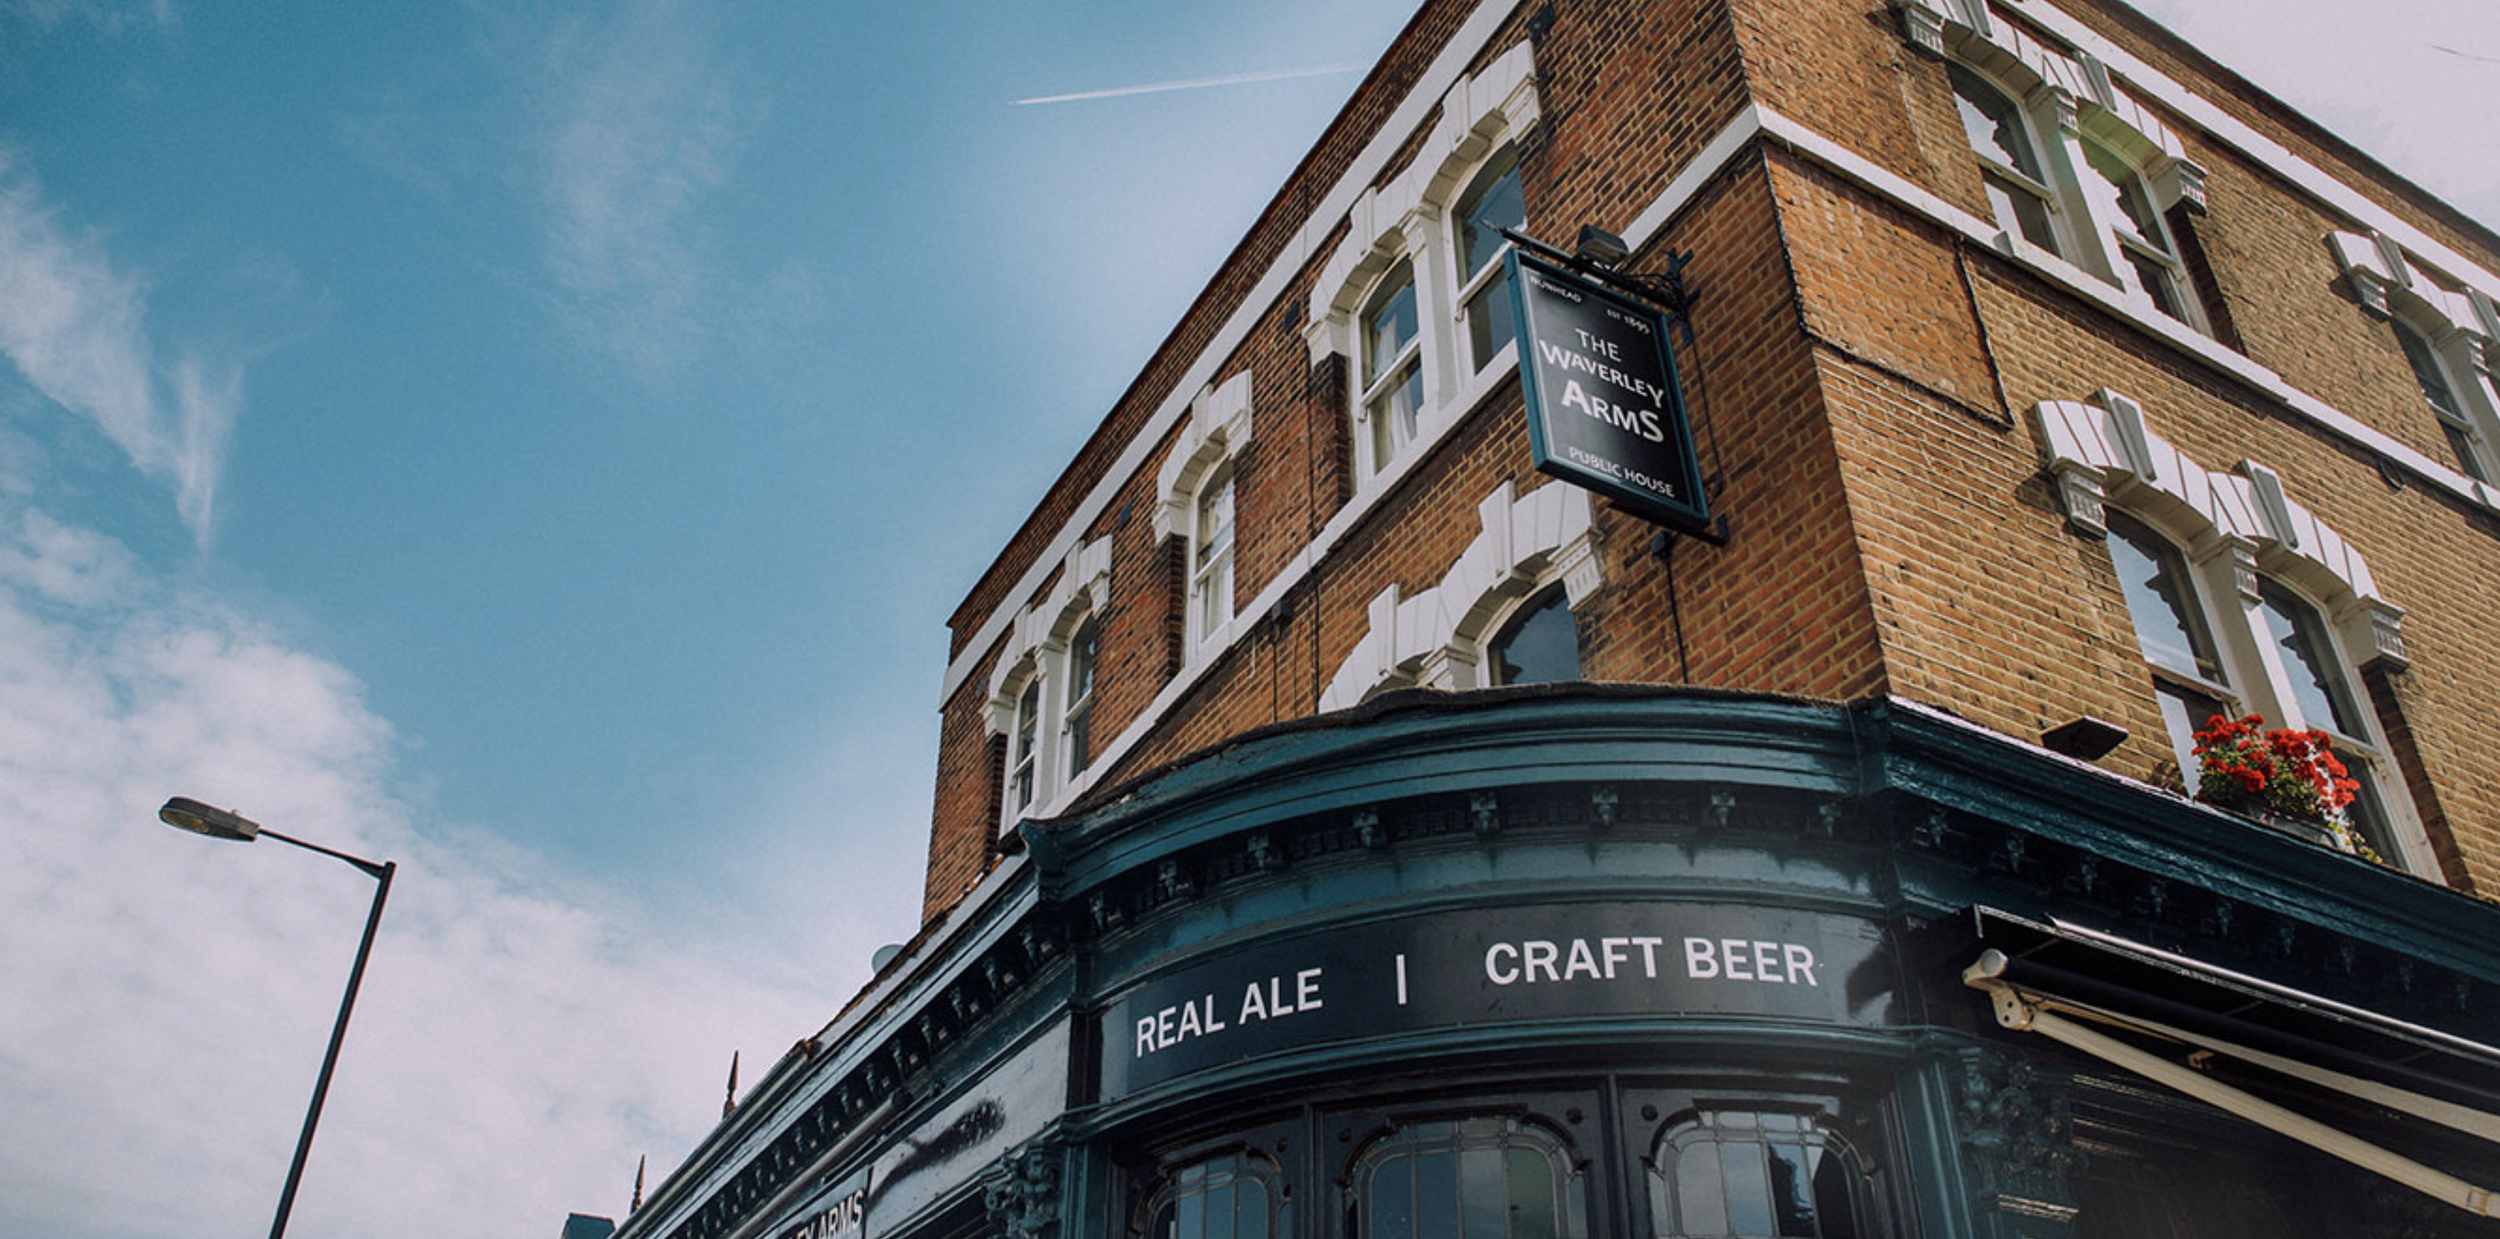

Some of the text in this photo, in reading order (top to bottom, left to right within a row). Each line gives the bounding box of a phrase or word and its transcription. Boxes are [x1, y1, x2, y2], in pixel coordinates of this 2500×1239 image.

[1539, 339, 1665, 409] WAVERLEY
[1575, 328, 1622, 363] THE
[1561, 379, 1665, 443] ARMS
[1569, 446, 1675, 498] PUBLIC HOUSE
[1136, 994, 1225, 1058] REAL
[1239, 967, 1323, 1025] ALE
[1485, 937, 1663, 985] CRAFT
[1683, 937, 1818, 986] BEER
[818, 1190, 863, 1239] ARMS
